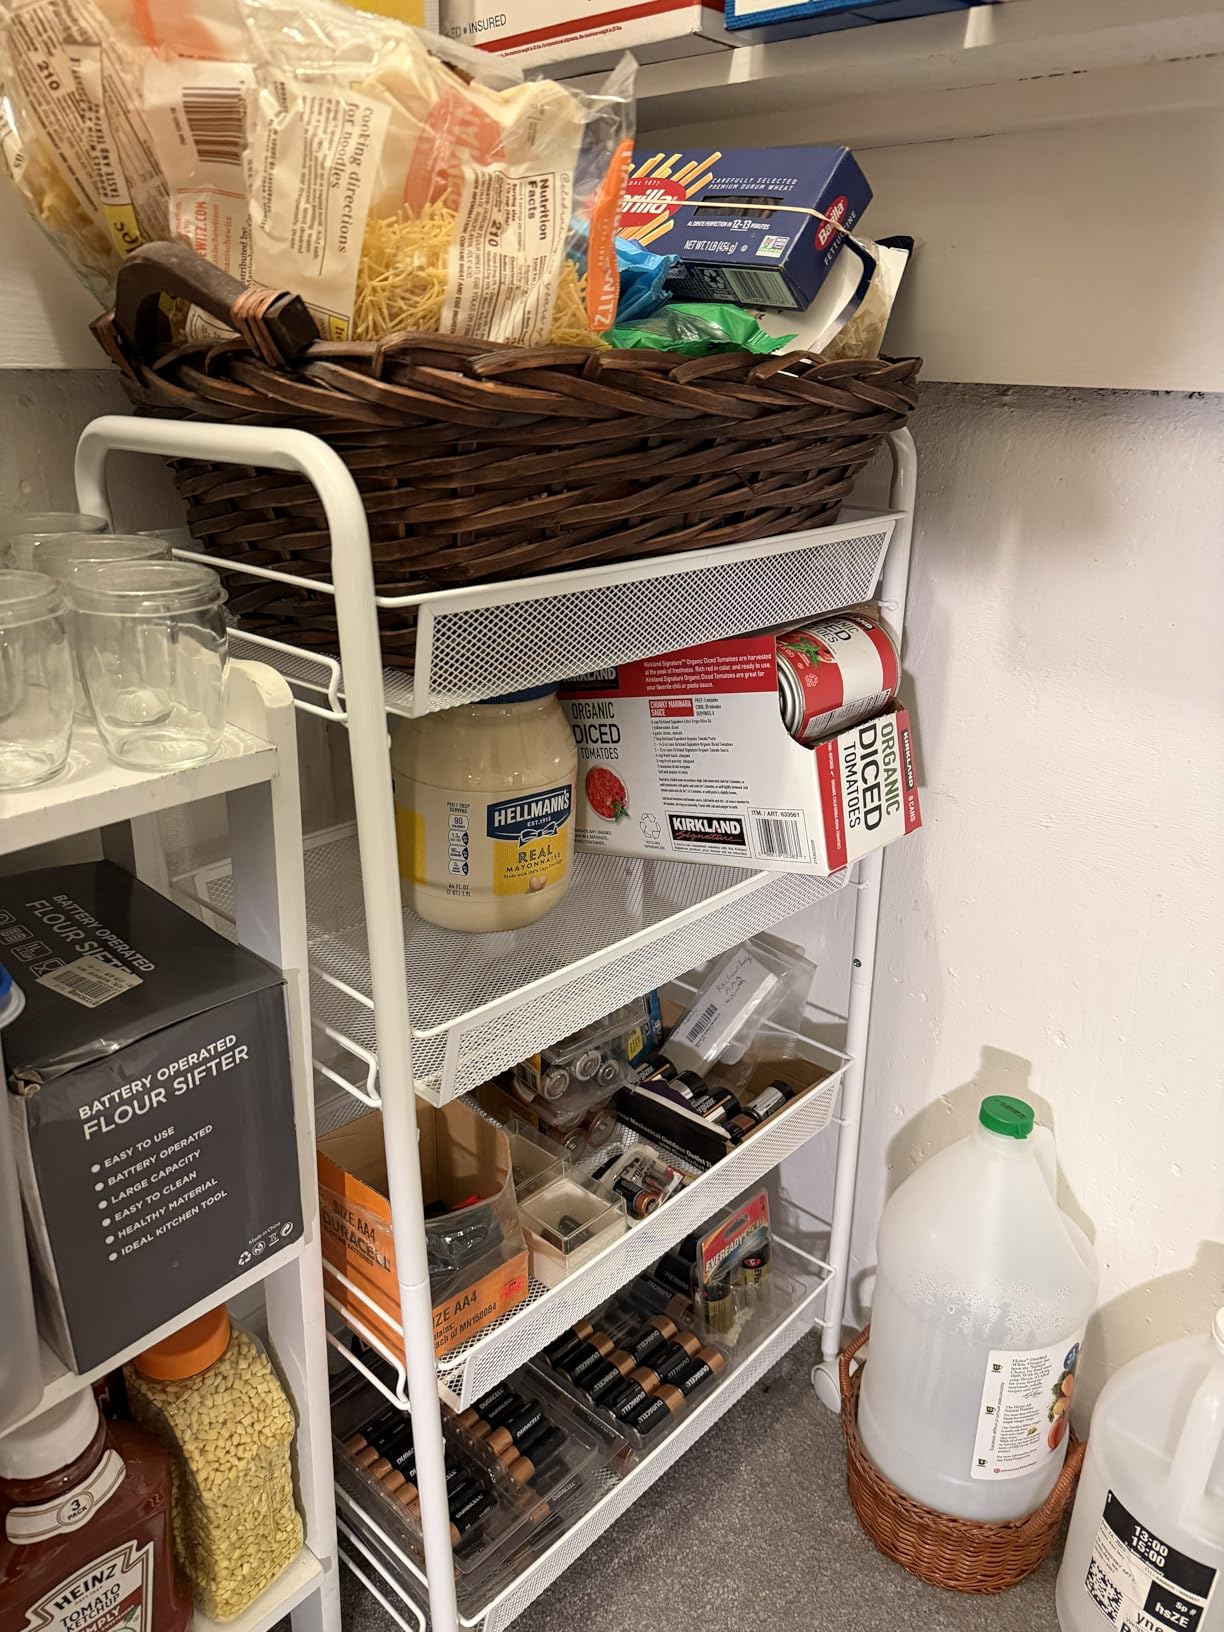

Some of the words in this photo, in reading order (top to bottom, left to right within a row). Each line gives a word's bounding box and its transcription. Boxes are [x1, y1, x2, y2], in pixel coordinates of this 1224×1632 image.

[468, 13, 507, 35] INSURED
[35, 59, 61, 92] 210
[342, 101, 360, 127] for
[350, 106, 375, 167] cooking
[100, 144, 113, 168] AND
[330, 130, 354, 190] noodles
[106, 169, 121, 200] TASTE
[336, 170, 364, 254] directions
[527, 179, 537, 220] Facts
[538, 178, 548, 241] Nutrition
[487, 219, 501, 247] 210
[731, 219, 751, 228] 12-13
[814, 200, 846, 245] Bailla
[475, 232, 485, 252] FLOUR
[683, 240, 695, 250] NET
[708, 241, 717, 252] LB
[716, 241, 729, 253] (454
[657, 667, 666, 675] peak
[705, 665, 713, 673] red
[686, 657, 703, 665] Organic
[703, 656, 715, 664] Diced
[715, 655, 738, 664] Tomatoes
[738, 655, 746, 663] are
[746, 653, 771, 662] harvested
[645, 674, 663, 683] Kirkland
[664, 674, 683, 682] Signature
[684, 673, 700, 681] Organic
[700, 673, 713, 681] Diced
[713, 672, 735, 680] Tomatoes
[743, 671, 756, 679] great
[756, 671, 764, 679] for
[571, 702, 615, 718] ORGANIC
[649, 699, 667, 707] CHUNKY
[668, 699, 692, 707] MARINARA
[650, 708, 666, 716] SAUCE
[571, 724, 621, 743] DICED
[579, 747, 619, 759] TOMATOES
[901, 731, 914, 788] KIRKLAND
[857, 722, 884, 831] DICED
[880, 721, 900, 816] ORGANIC
[843, 741, 861, 829] TOMATOES
[493, 791, 570, 827] HELLMANN'S
[671, 817, 741, 834] KIRKLAND
[674, 830, 738, 842] Signature
[505, 852, 561, 873] MAYONNAISE
[517, 843, 553, 863] REAL
[25, 899, 85, 942] FLOUR
[52, 894, 102, 929] BATTERY
[95, 928, 155, 972] OPERATED
[77, 1073, 154, 1120] BATTERY
[155, 1033, 238, 1082] OPERATED
[81, 1084, 168, 1141] FLOUR
[170, 1043, 251, 1095] SIFTER
[103, 1146, 134, 1168] EASY
[135, 1137, 152, 1152] TO
[153, 1125, 176, 1143] USE
[106, 1152, 158, 1186] BATTERY
[158, 1123, 214, 1159] OPERATED
[629, 1117, 661, 1139] Mechanical
[660, 1135, 686, 1153] Outdoor
[685, 1150, 705, 1165] Outlet
[109, 1176, 149, 1204] LARGE
[149, 1148, 202, 1183] CAPACITY
[113, 1198, 144, 1222] EASY
[144, 1189, 161, 1205] TO
[161, 1169, 198, 1196] CLEAN
[116, 1204, 167, 1239] HEALTHY
[167, 1176, 218, 1211] MATERIAL
[120, 1230, 154, 1257] IDEAL
[154, 1204, 200, 1237] KITCHEN
[199, 1188, 228, 1211] TOOL
[332, 1202, 359, 1226] SIZE
[247, 1233, 263, 1245] Made
[266, 1221, 281, 1232] China
[319, 1210, 396, 1272] DURACELL
[705, 1233, 743, 1273] EVEREADY
[635, 1329, 659, 1351] DURACELL
[573, 1350, 599, 1374] DURACELL
[592, 1367, 618, 1391] DURACELL
[683, 1363, 709, 1389] DURACELL
[478, 1386, 505, 1410] DURACELL
[619, 1390, 646, 1415] DURACELL
[636, 1398, 663, 1423] DURACELL
[515, 1412, 542, 1438] DURACELL
[66, 1505, 88, 1520] PACK
[68, 1498, 82, 1512] 3
[454, 1493, 484, 1519] DURACELL
[1128, 1535, 1167, 1568] 15:00
[1131, 1524, 1170, 1557] 13:00
[53, 1563, 121, 1612] HEINZ
[59, 1582, 122, 1627] TOMATO
[64, 1592, 122, 1632] KETCHUP
[1153, 1601, 1190, 1628] hsZE
[1173, 1600, 1188, 1613] Sp
